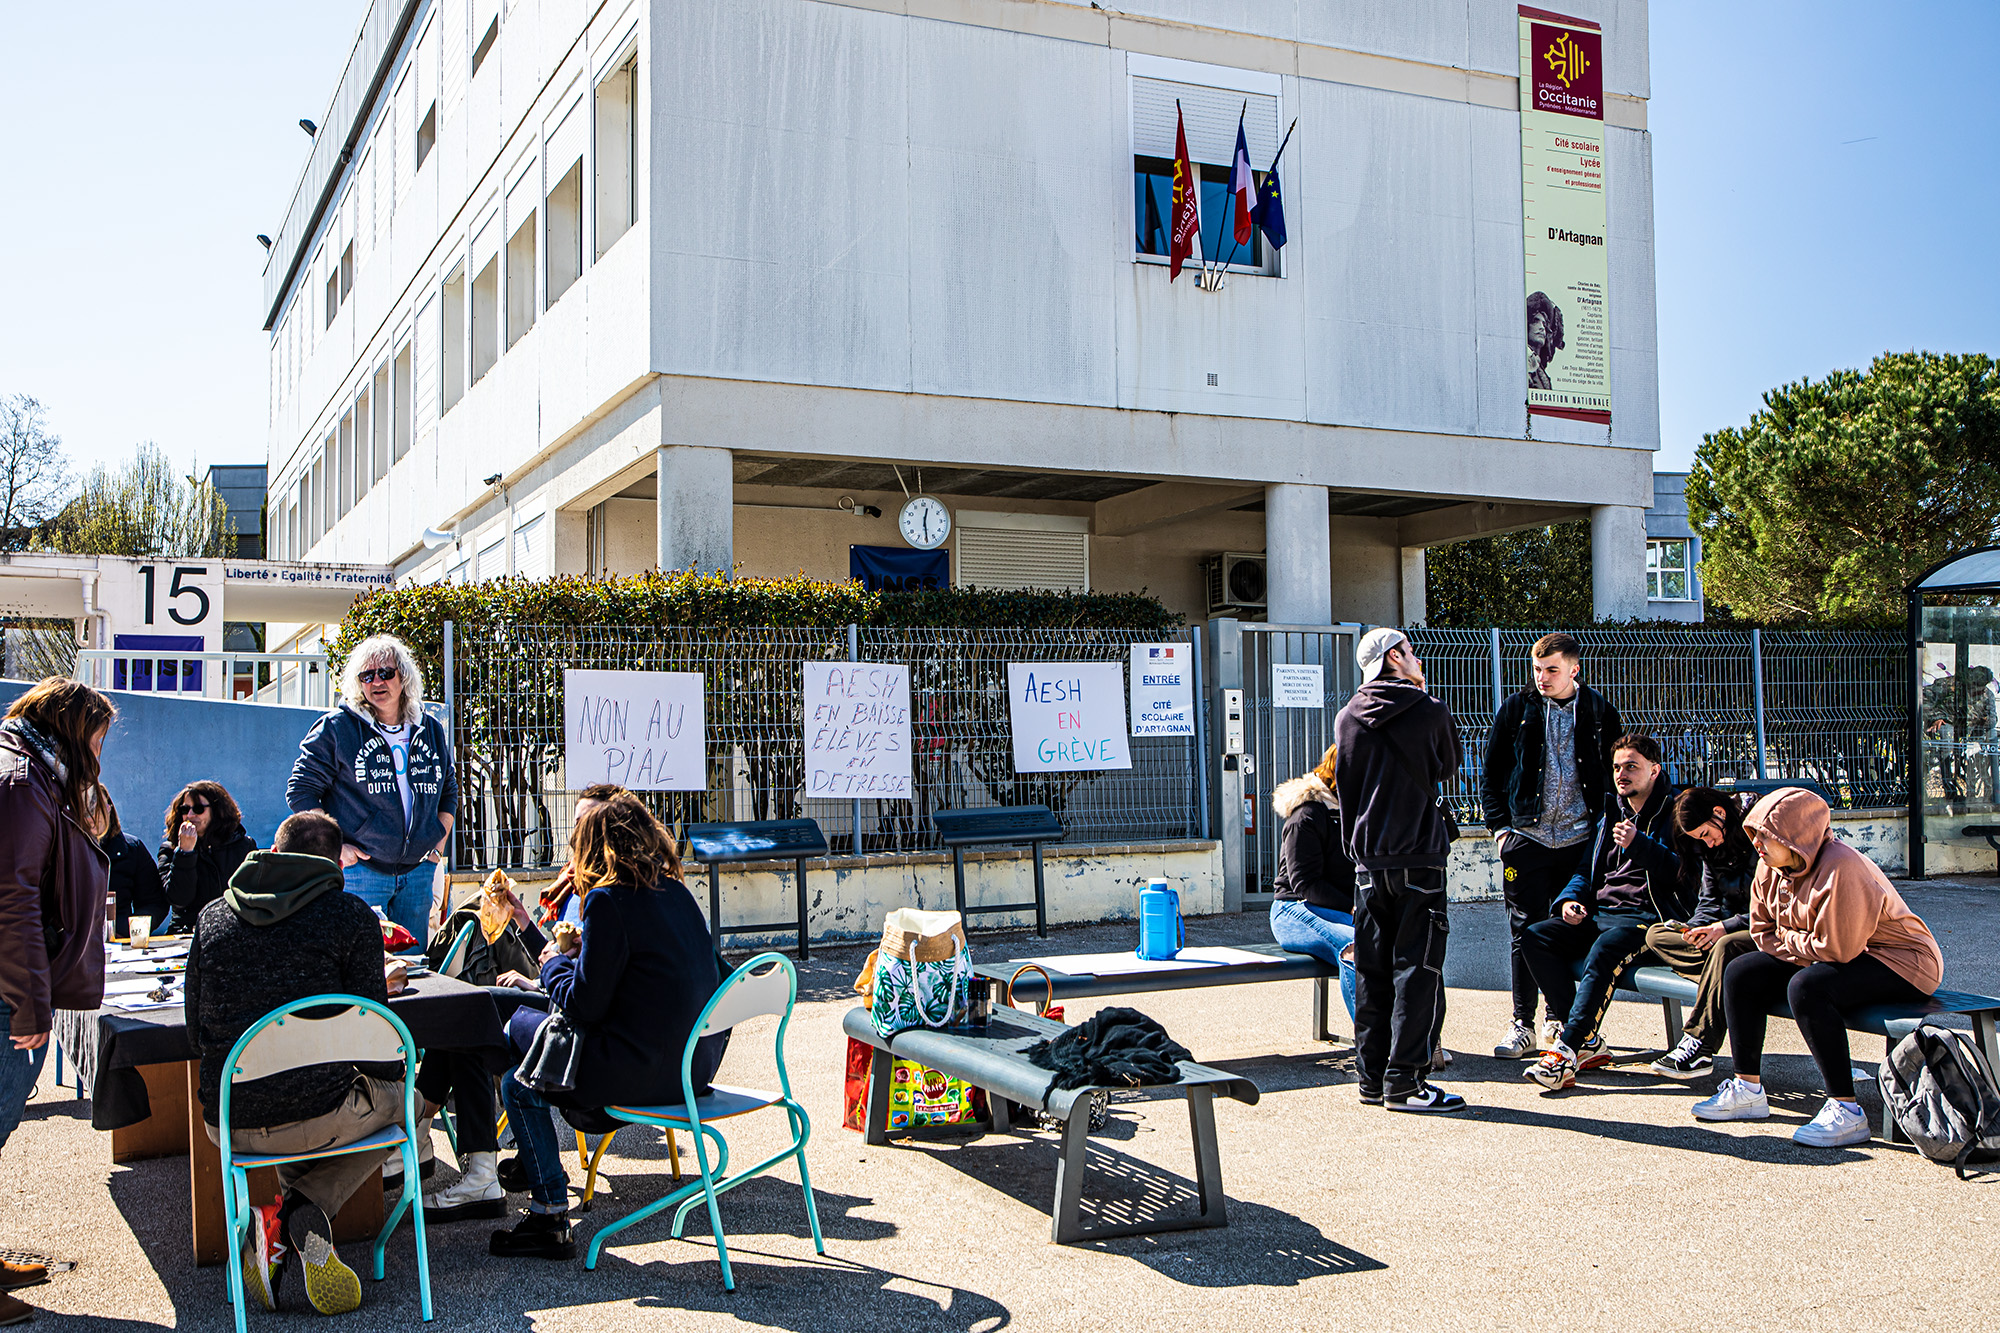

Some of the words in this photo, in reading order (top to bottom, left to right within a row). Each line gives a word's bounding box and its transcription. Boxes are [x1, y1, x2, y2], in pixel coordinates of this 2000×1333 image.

[1539, 89, 1597, 109] Occitanie
[1555, 137, 1569, 148] Cité
[1571, 142, 1599, 152] scolaire
[1580, 157, 1600, 168] Lycée
[1548, 227, 1603, 246] D'Artagnan
[1577, 296, 1602, 305] D'Artagnan
[1530, 392, 1568, 404] ÉDUCATION
[1572, 395, 1609, 407] NATIONALE
[226, 568, 269, 580] Liberté
[281, 570, 322, 583] Egalité
[334, 571, 392, 584] Fraternité
[138, 565, 210, 626] 15
[826, 668, 900, 700] AESH
[1142, 672, 1180, 685] ENTRÉE
[813, 704, 840, 722] EN
[1153, 700, 1172, 710] CITÉ
[576, 696, 630, 745] NON
[644, 698, 686, 742] AU
[1058, 710, 1081, 730] EN
[1141, 712, 1184, 722] SCOLAIRE
[1136, 724, 1190, 734] D'ARTAGNAN
[811, 722, 901, 754] ÉLÈVES
[812, 769, 910, 794] DETRESSE
